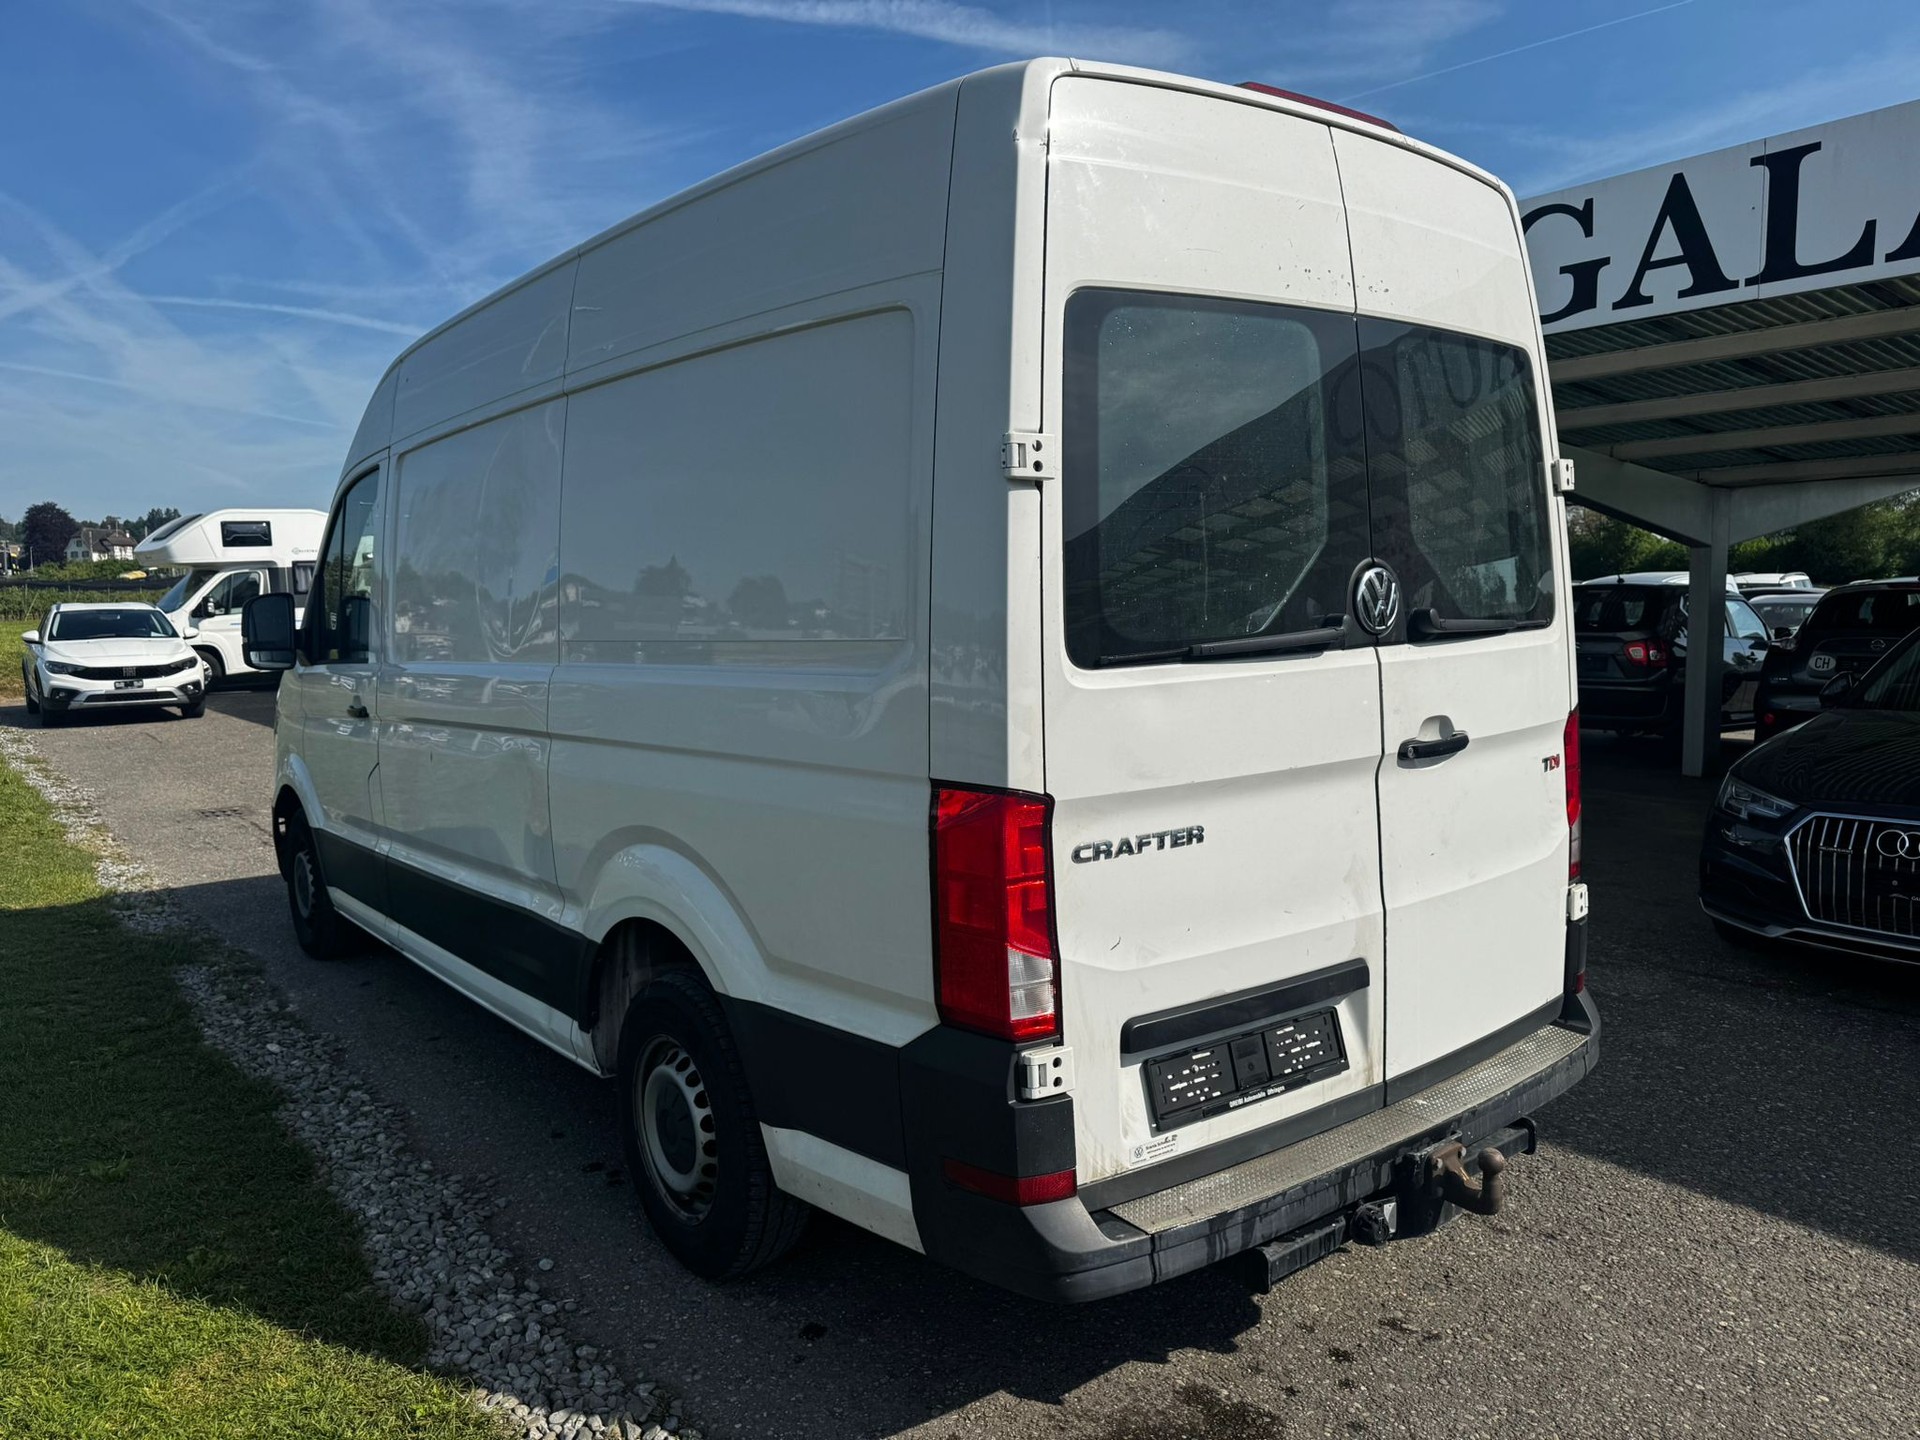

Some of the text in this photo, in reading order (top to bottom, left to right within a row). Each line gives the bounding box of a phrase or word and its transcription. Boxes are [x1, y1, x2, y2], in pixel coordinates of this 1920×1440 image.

[1814, 657, 1830, 669] CH
[1541, 753, 1560, 773] TDI
[1070, 825, 1205, 865] CRAFTER
